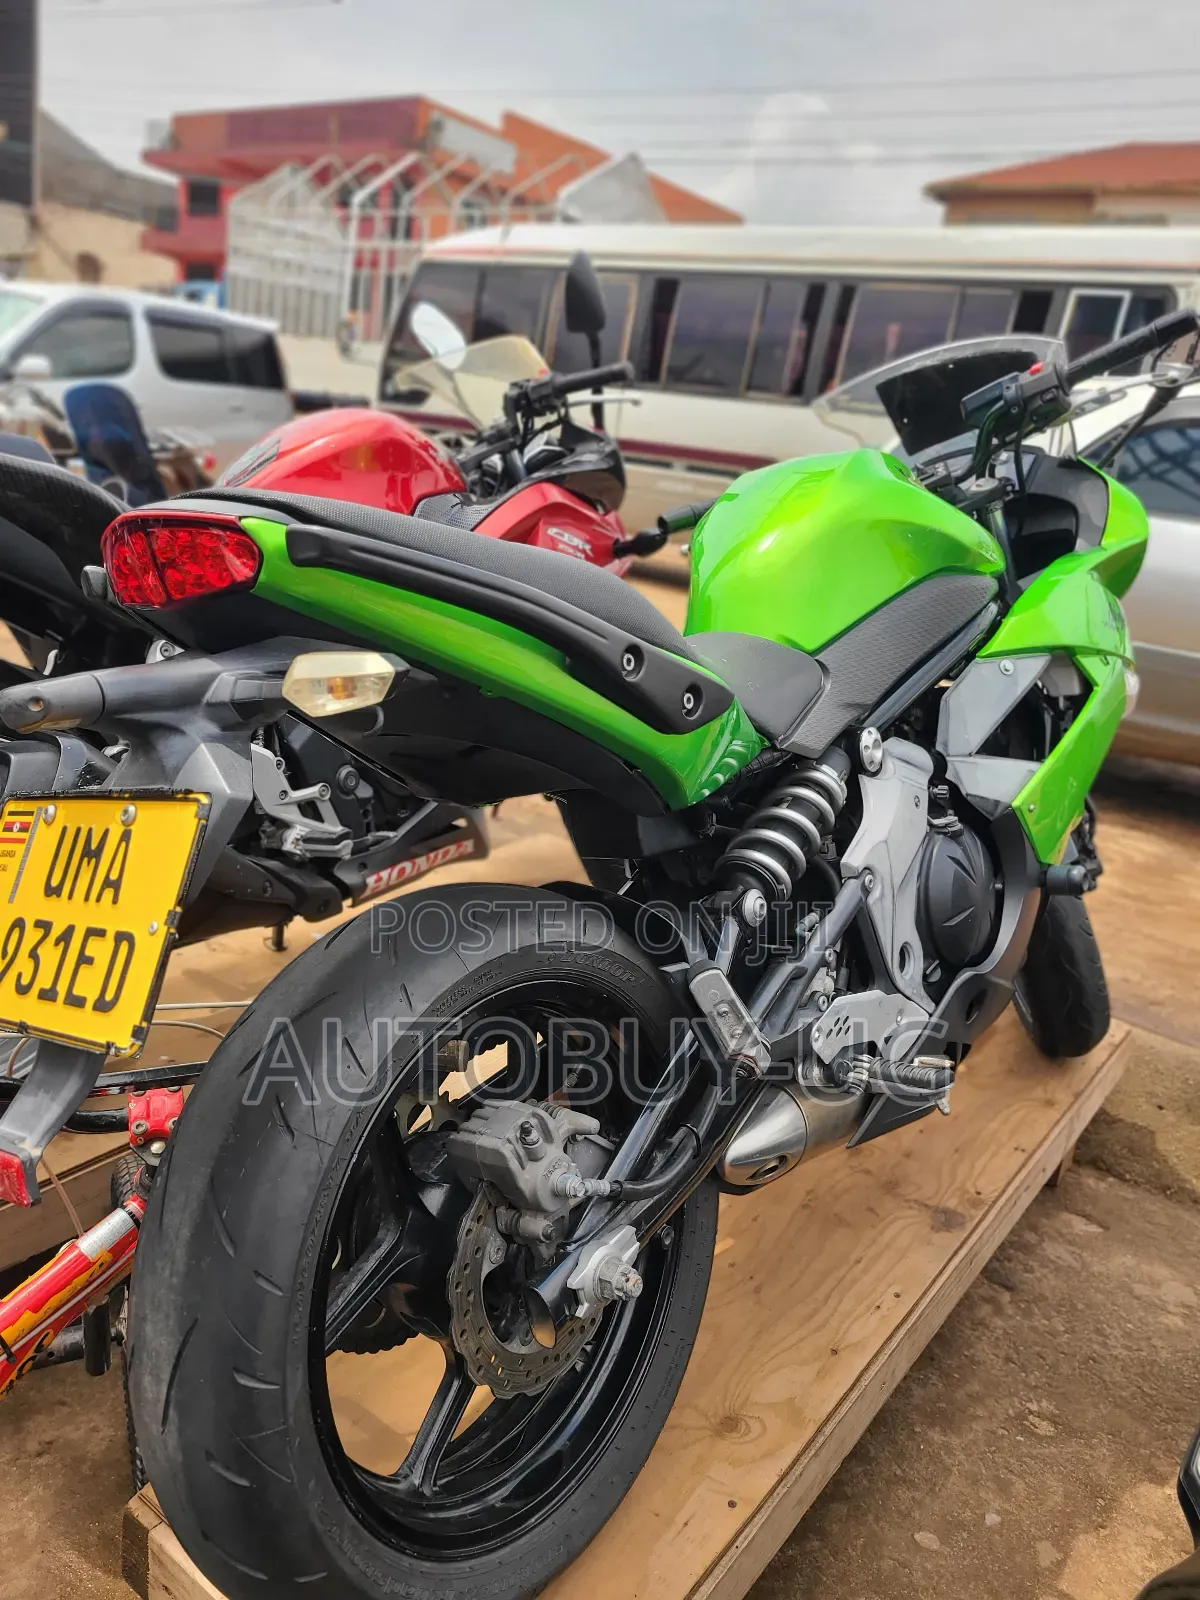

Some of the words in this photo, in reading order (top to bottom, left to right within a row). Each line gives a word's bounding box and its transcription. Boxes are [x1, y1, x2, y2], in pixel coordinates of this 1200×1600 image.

[547, 527, 595, 558] CBR
[43, 824, 132, 905] UMA
[360, 838, 475, 899] HONDA
[0, 917, 136, 1013] 931ED
[561, 949, 637, 982] DUNLOP
